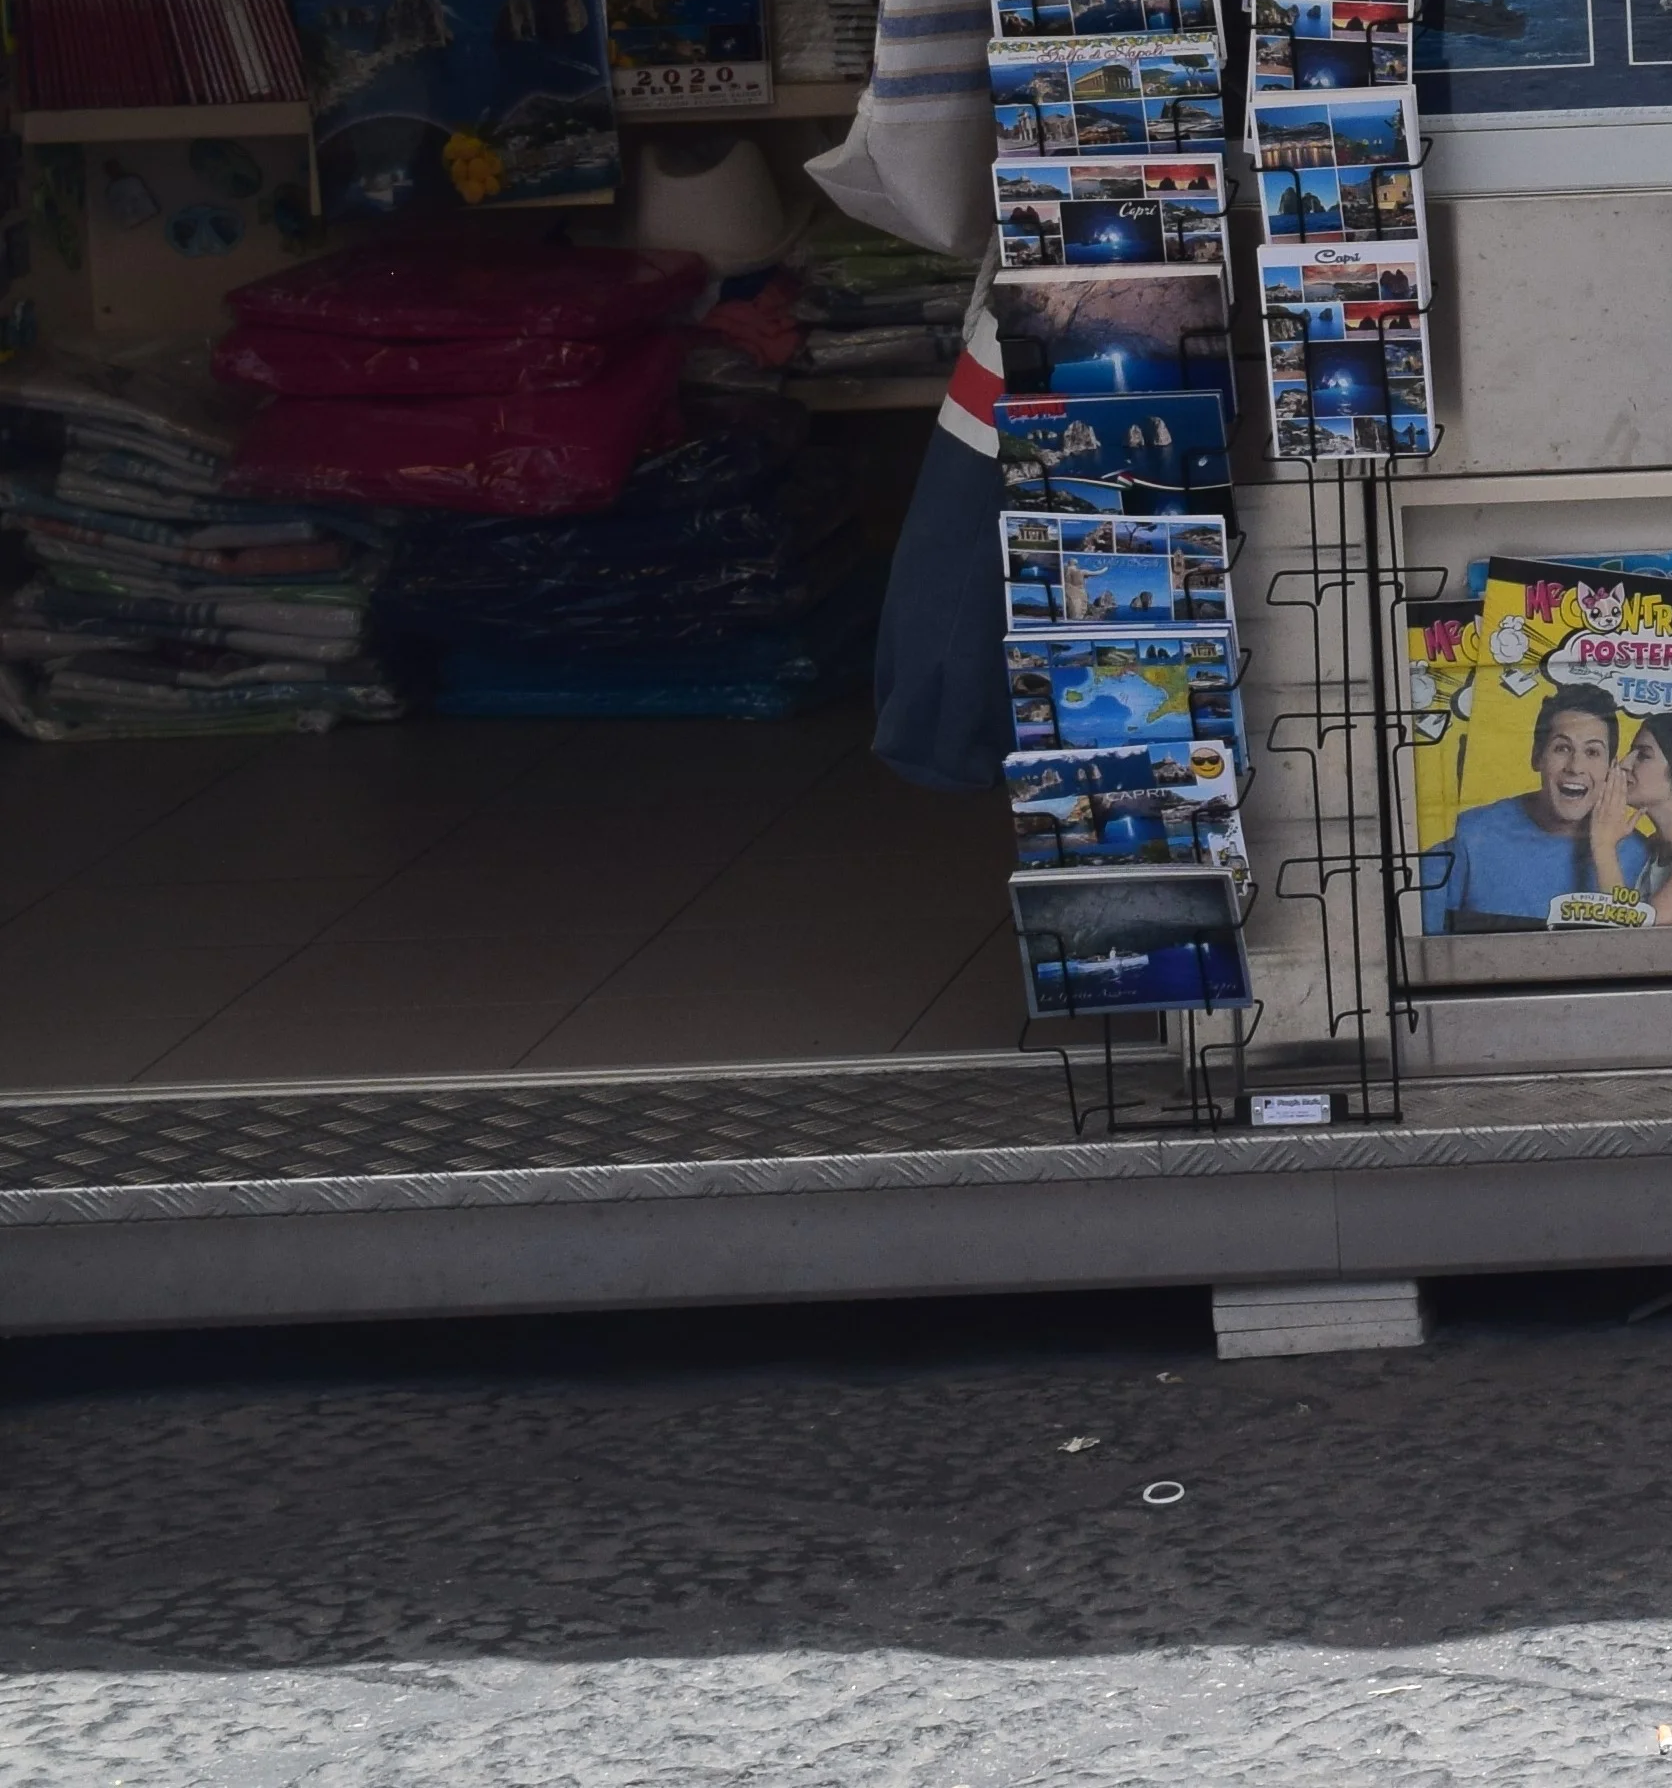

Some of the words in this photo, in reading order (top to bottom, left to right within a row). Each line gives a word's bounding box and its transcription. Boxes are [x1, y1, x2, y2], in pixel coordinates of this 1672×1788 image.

[635, 67, 735, 88] 2020
[1119, 200, 1157, 221] Capri
[1313, 246, 1362, 267] Capri
[1104, 786, 1168, 803] CAPRI
[1611, 885, 1641, 906] 100
